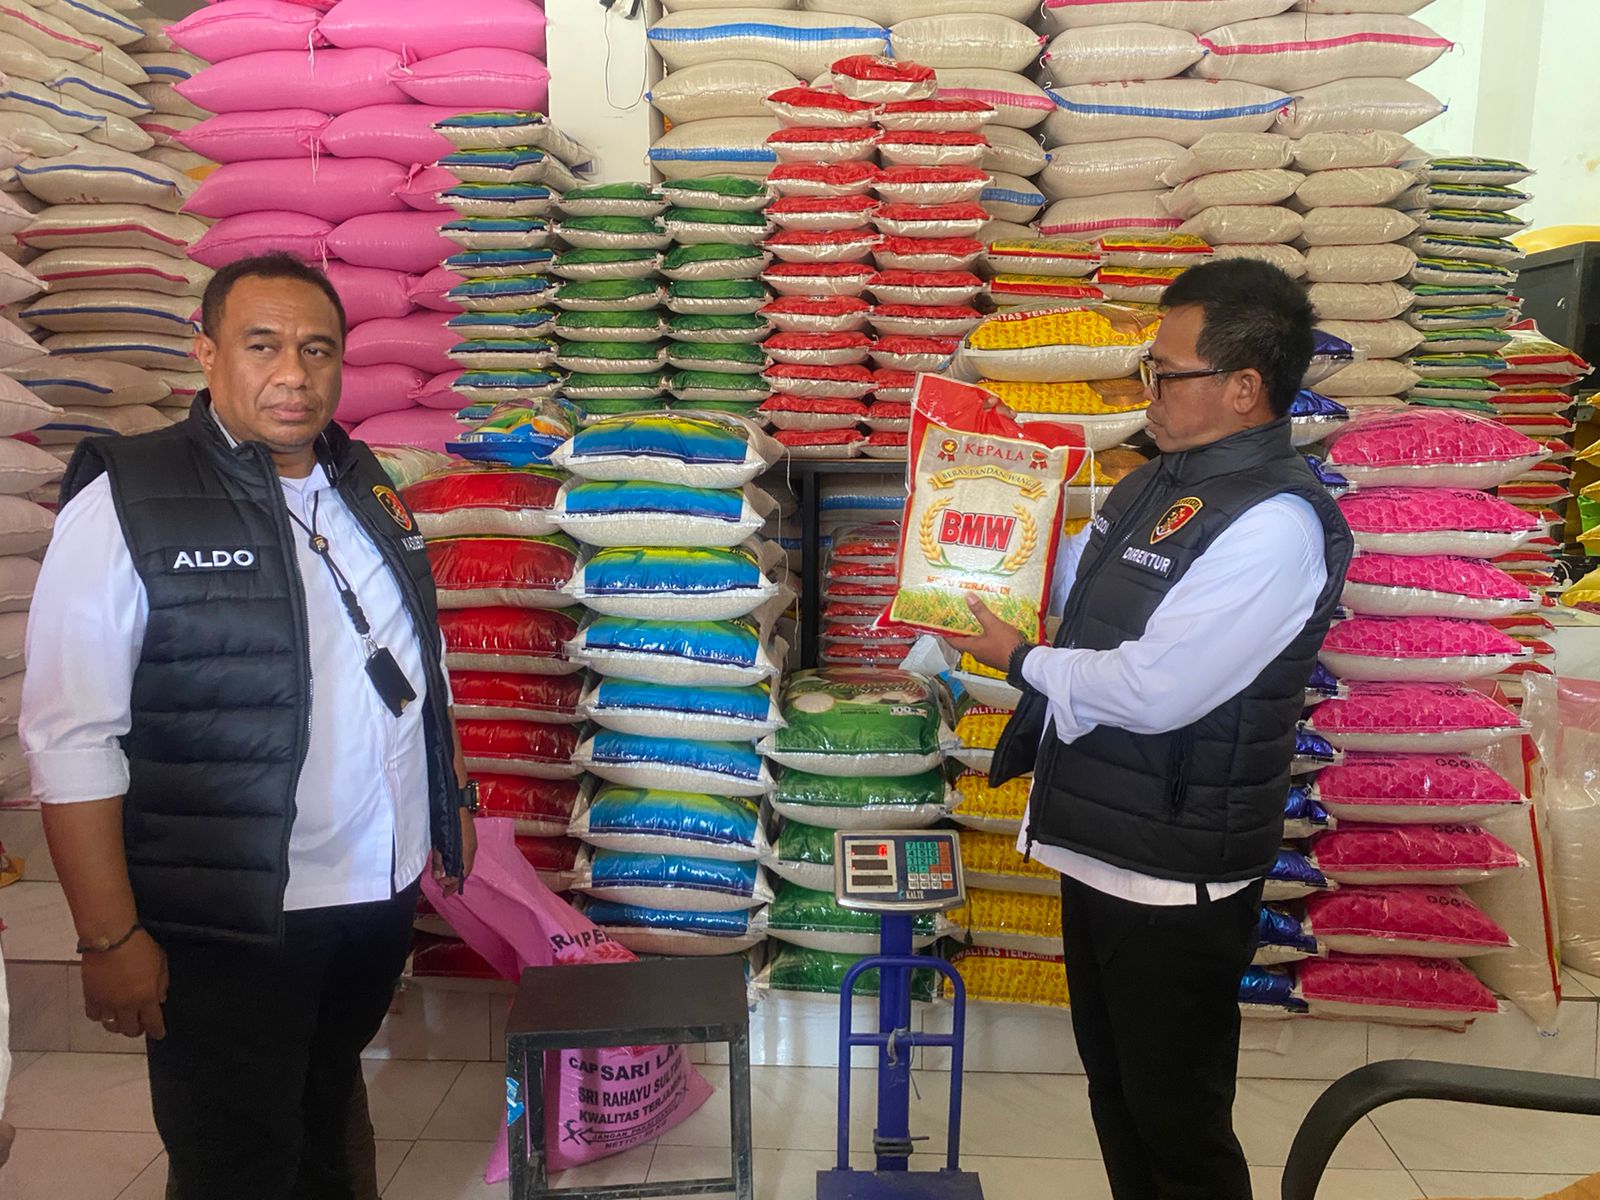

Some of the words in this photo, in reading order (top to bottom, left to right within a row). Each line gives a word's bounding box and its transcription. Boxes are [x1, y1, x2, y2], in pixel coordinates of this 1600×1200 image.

[1026, 306, 1082, 318] TERJAMIN
[964, 443, 1025, 461] KEPALA
[970, 466, 1005, 480] PANDAN
[938, 509, 1017, 552] BMW
[173, 549, 255, 569] ALDO
[1121, 547, 1172, 573] DIREKTUR
[568, 1056, 599, 1074] CAP
[601, 1061, 651, 1081] SARI
[578, 1087, 599, 1106] SRI
[602, 1084, 652, 1108] RAHAYU
[579, 1109, 640, 1125] KWALITAS
[592, 1131, 628, 1140] JANGAN
[605, 1136, 637, 1149] NETTO
